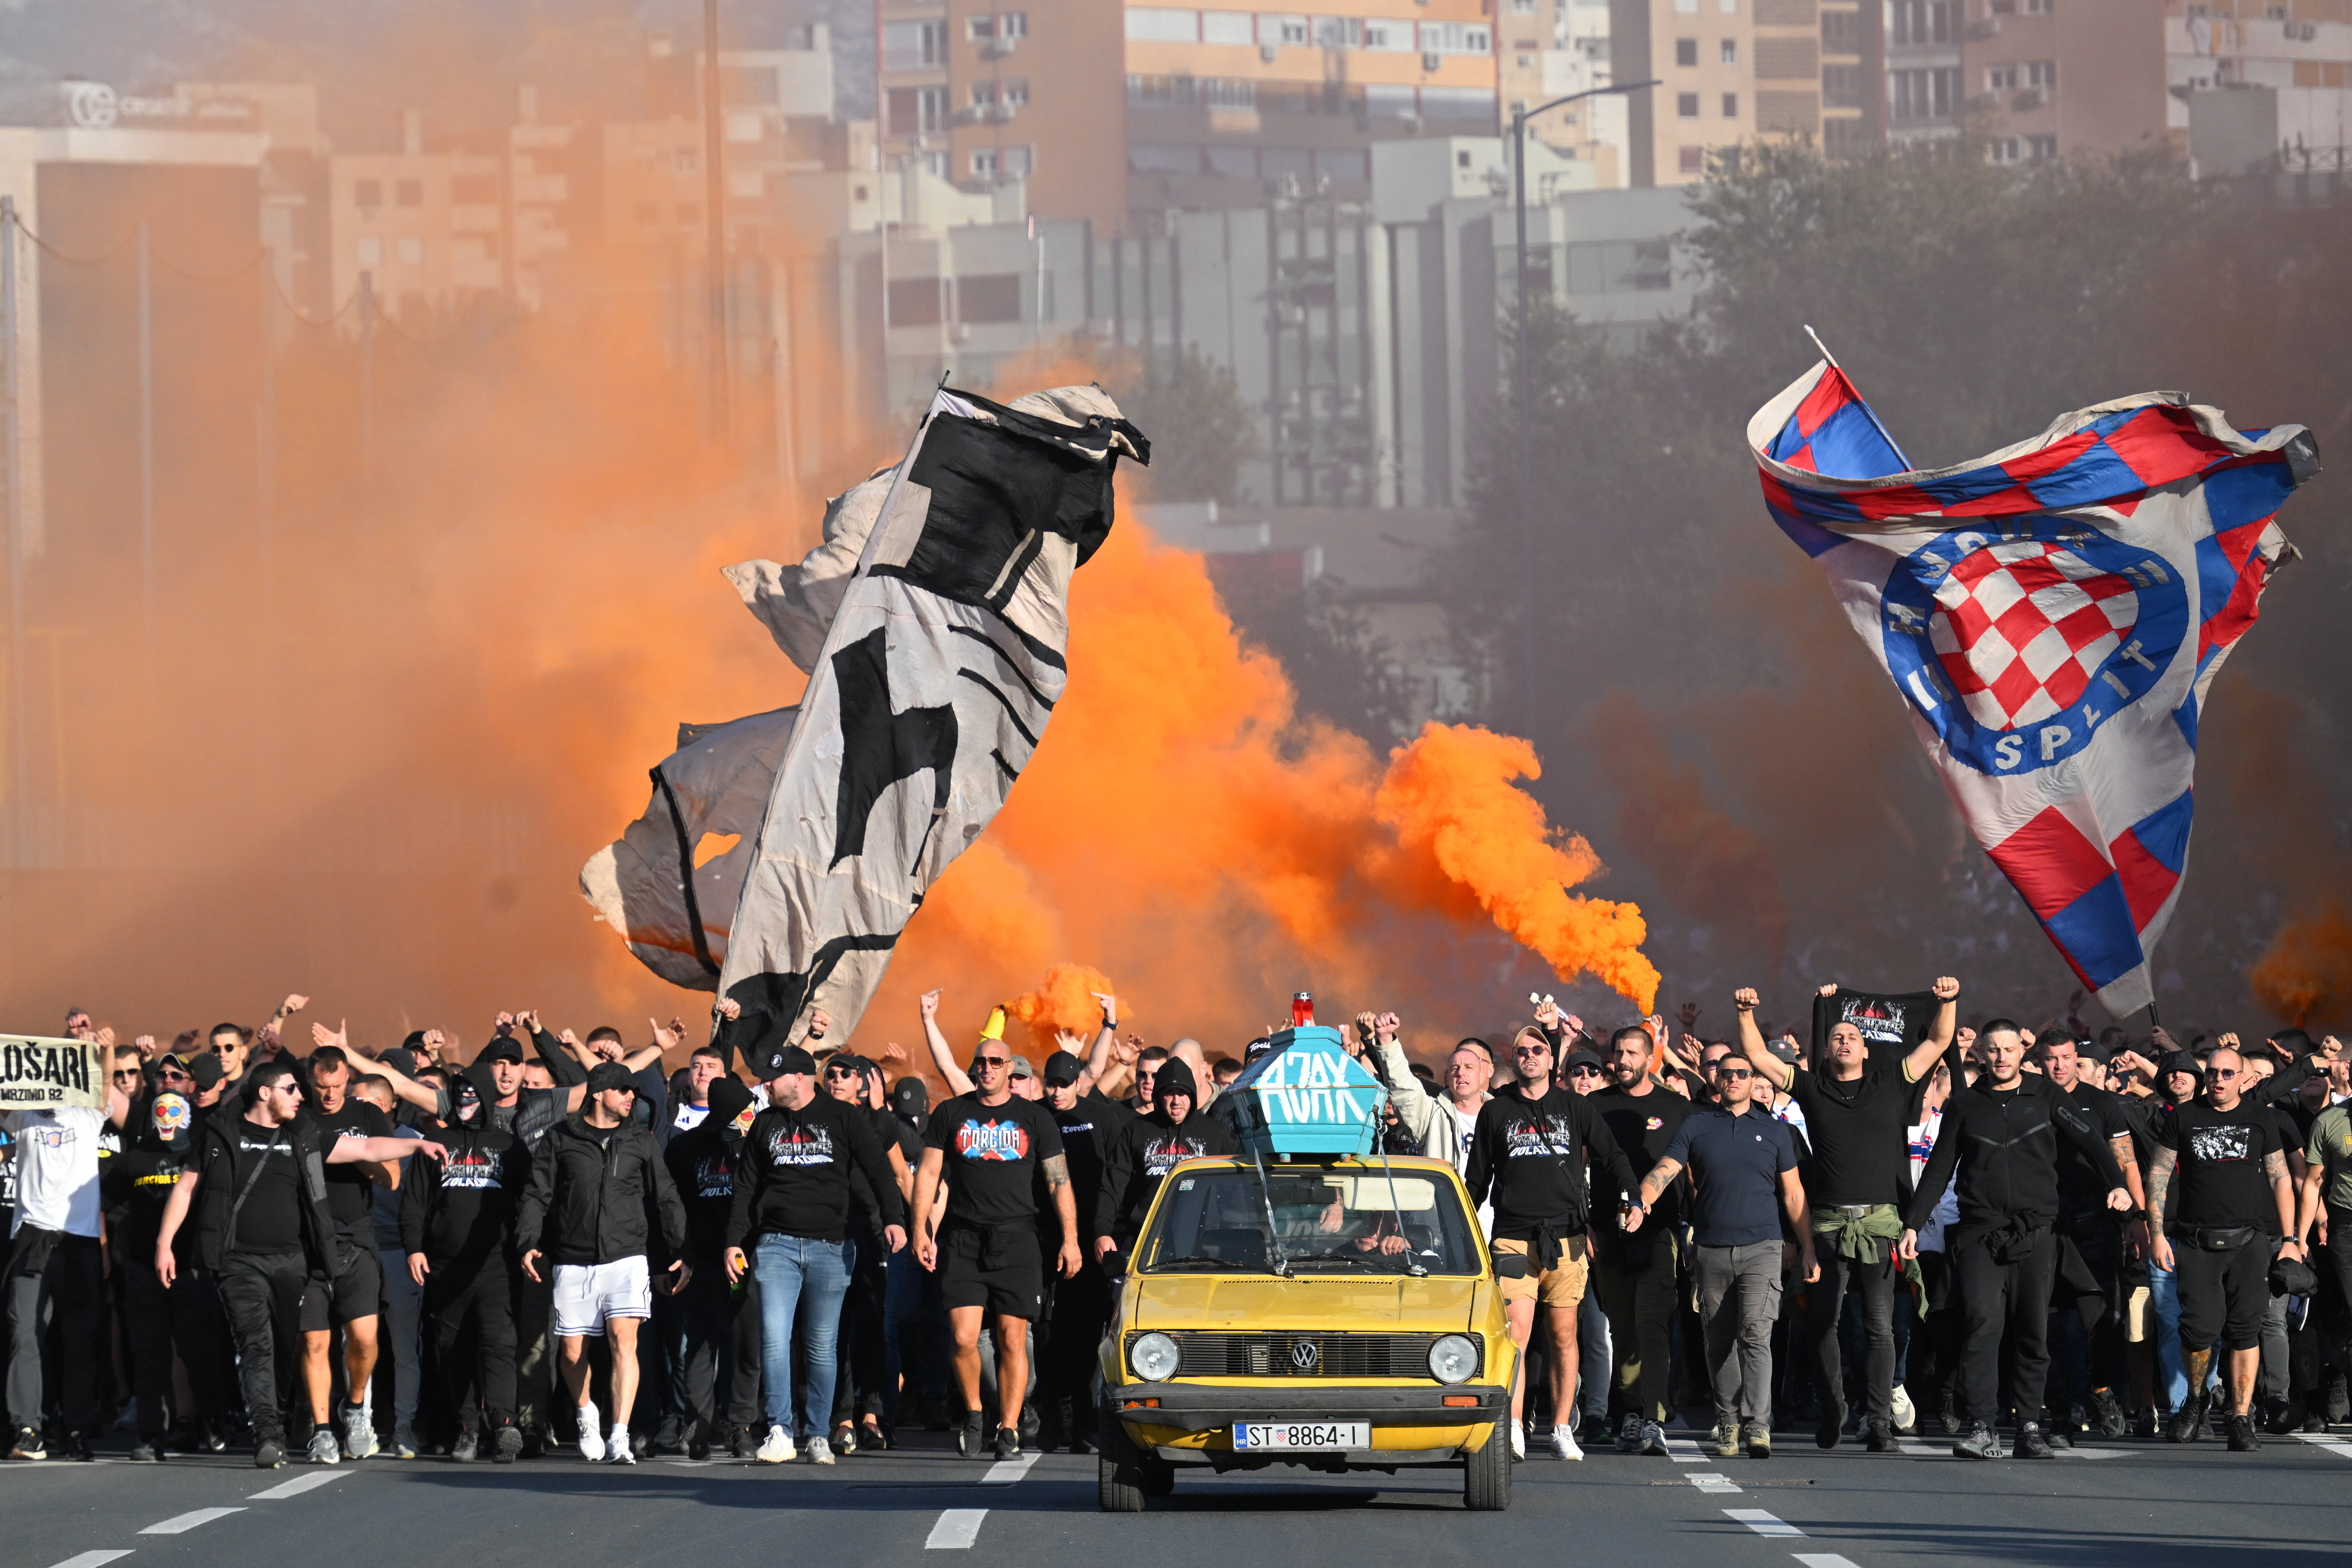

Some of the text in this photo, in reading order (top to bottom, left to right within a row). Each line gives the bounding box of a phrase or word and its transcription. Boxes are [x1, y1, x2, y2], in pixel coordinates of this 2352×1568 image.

[1250, 1042, 1271, 1052] Torcid
[0, 1041, 90, 1094] OŠARI
[1256, 1051, 1366, 1124] AJAX
[960, 1130, 1020, 1148] TORCIDA
[1250, 1427, 1272, 1446] ST
